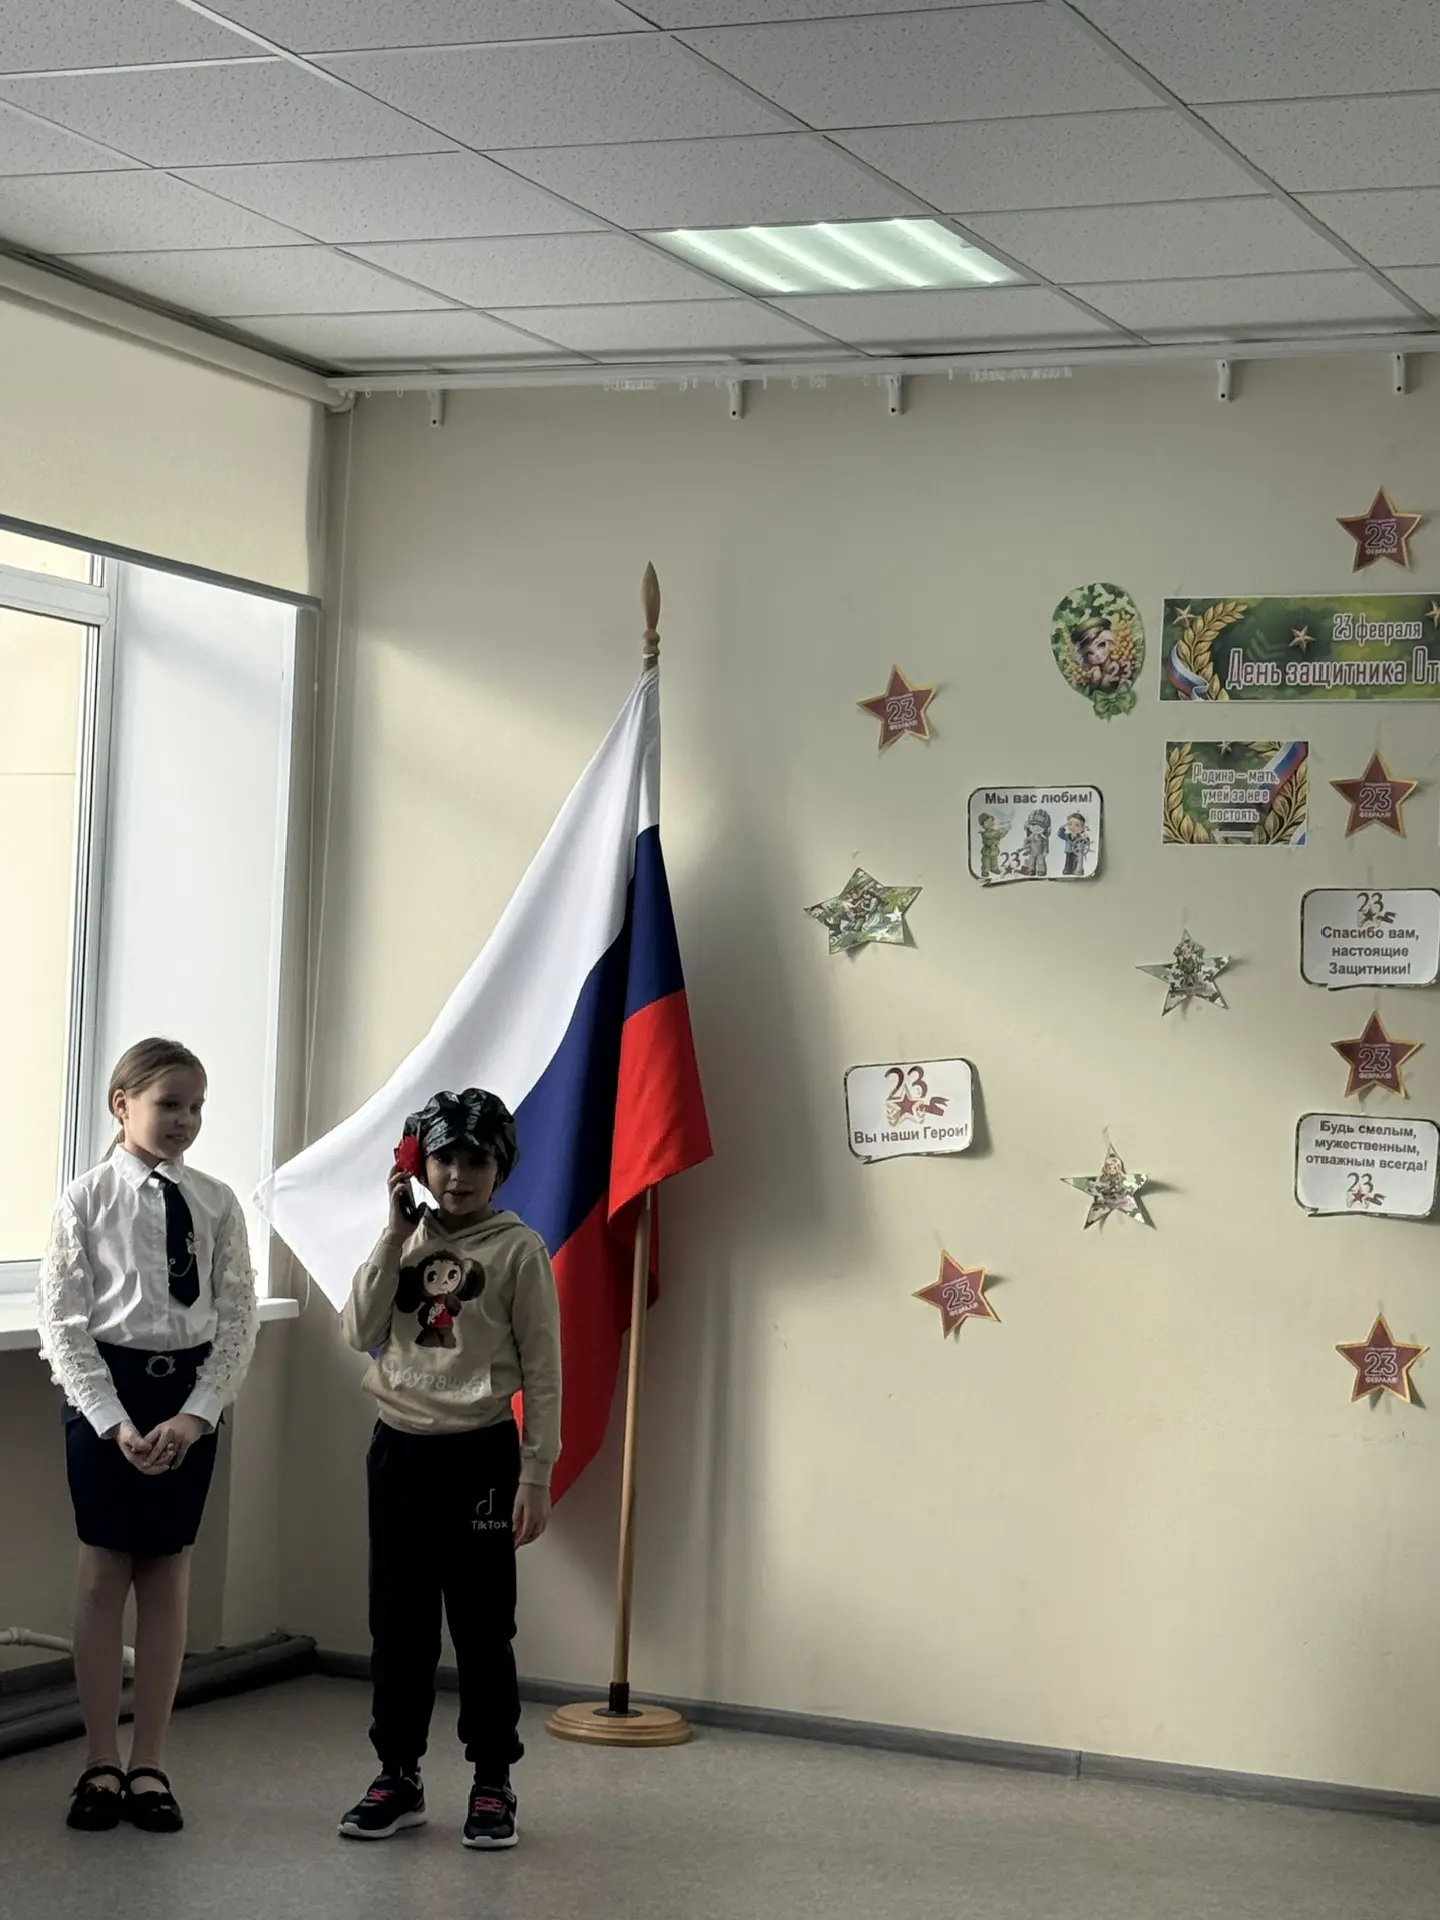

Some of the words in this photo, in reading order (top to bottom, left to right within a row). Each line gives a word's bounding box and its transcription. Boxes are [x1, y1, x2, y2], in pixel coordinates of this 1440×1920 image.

[1365, 522, 1398, 548] 23
[1332, 613, 1352, 641] 23
[1355, 613, 1422, 646] февраля
[1225, 648, 1282, 690] День
[1285, 659, 1407, 689] защитника
[886, 696, 917, 725] 23
[1192, 762, 1235, 785] Родина
[985, 793, 1009, 804] Мы
[1013, 794, 1037, 803] вас
[1041, 791, 1093, 804] любим!
[1202, 786, 1231, 808] умей
[1231, 789, 1246, 803] за
[1359, 787, 1392, 812] 23
[1209, 808, 1260, 823] постоять
[1000, 852, 1021, 868] 23
[1357, 892, 1384, 913] 23
[1322, 926, 1384, 939] Спасибо
[1388, 929, 1419, 941] вам,
[1332, 946, 1409, 958] настоящие
[1329, 962, 1411, 976] Защитники!
[1358, 1047, 1392, 1073] 23
[884, 1065, 928, 1100] 23
[854, 1131, 877, 1144] Вы
[881, 1130, 919, 1142] наши
[923, 1124, 968, 1140] Герои!
[1320, 1121, 1354, 1135] Будь
[1358, 1124, 1417, 1139] смелым,
[1315, 1138, 1420, 1156] мужественным,
[1306, 1154, 1375, 1168] отважным
[1379, 1160, 1427, 1172] всегда!
[1347, 1172, 1374, 1193] 23
[942, 1280, 976, 1311] 23
[1364, 1351, 1398, 1377] 23
[471, 1520, 509, 1530] TikTok
